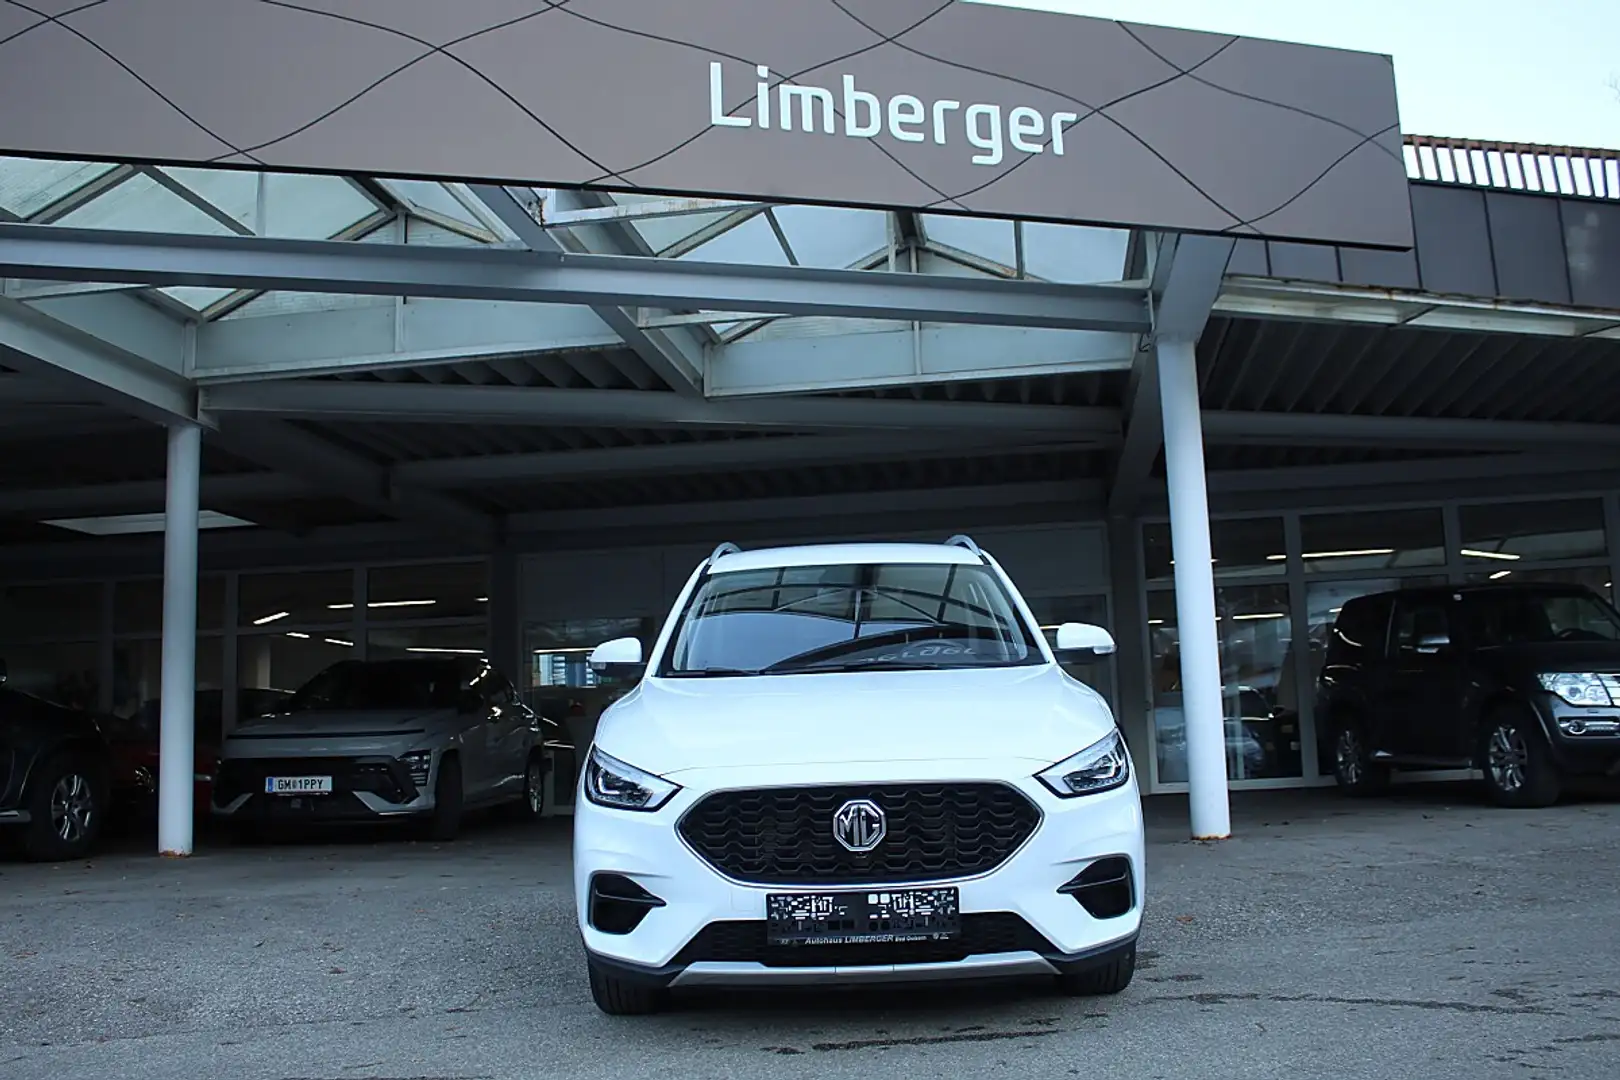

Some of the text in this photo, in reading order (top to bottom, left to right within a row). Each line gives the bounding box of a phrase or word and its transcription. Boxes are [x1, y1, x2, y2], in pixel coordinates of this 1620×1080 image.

[709, 61, 1078, 166] Limberger
[278, 779, 324, 790] GM 1PPY
[838, 803, 881, 847] MG
[804, 936, 842, 945] Autohaus
[844, 934, 894, 945] LIMBERGER
